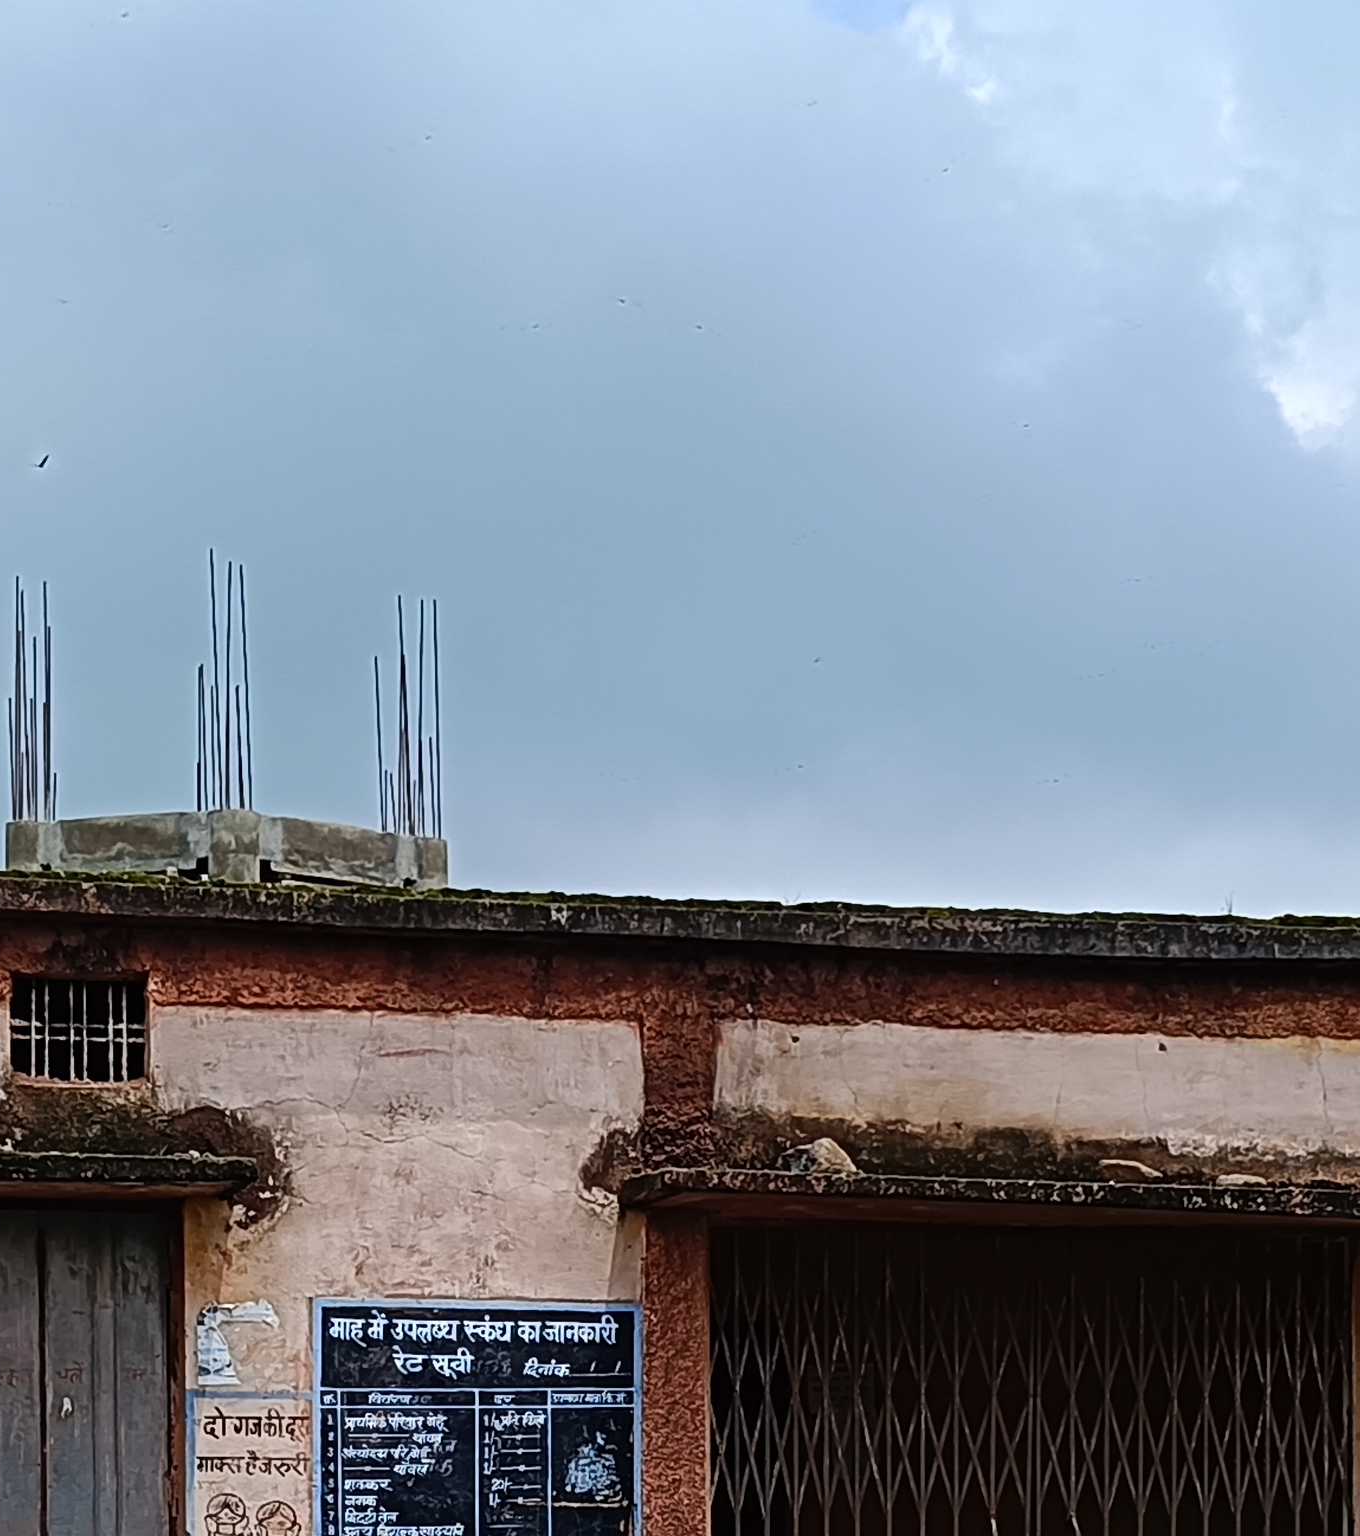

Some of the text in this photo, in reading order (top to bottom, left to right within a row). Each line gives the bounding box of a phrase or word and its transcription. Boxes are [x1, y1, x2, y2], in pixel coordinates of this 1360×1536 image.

[327, 1316, 367, 1347] माह
[366, 1309, 389, 1341] में
[543, 1314, 619, 1345] जानकारी
[392, 1345, 430, 1374] रेट
[522, 1357, 571, 1378] दिनांक
[203, 1405, 236, 1440] दो
[234, 1416, 262, 1438] गज
[263, 1407, 286, 1438] की
